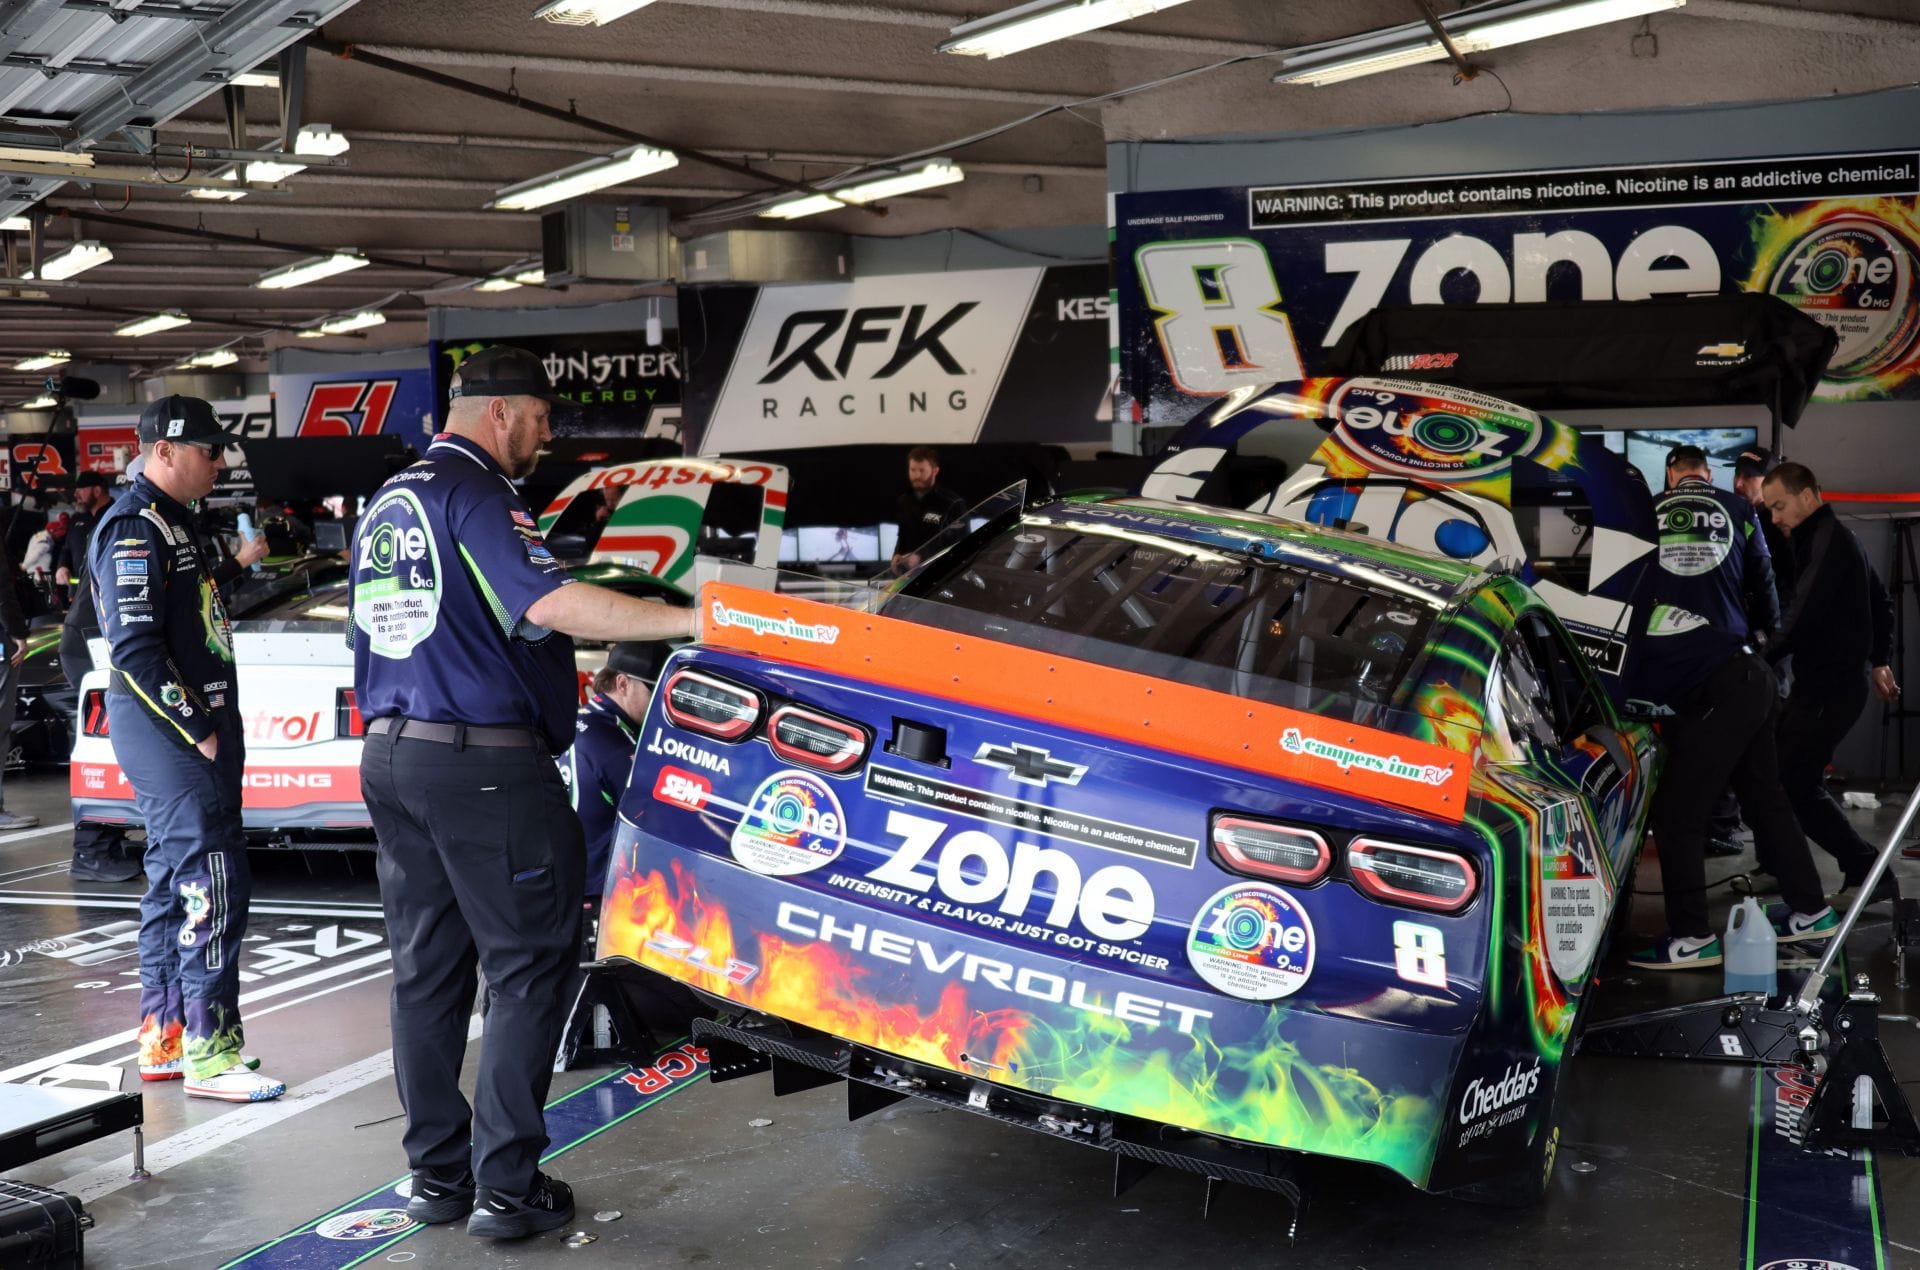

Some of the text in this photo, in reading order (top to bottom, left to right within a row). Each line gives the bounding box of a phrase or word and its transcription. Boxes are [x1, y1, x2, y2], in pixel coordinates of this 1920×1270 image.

[1256, 164, 1916, 214] WARNING: This product contains nicotine. Nicotine is an addictive chemical.
[1127, 213, 1224, 226] UNDERAGE SALE PROHIBITED
[1826, 231, 1851, 242] NICOTINE
[1852, 231, 1876, 244] POUCHES
[1790, 250, 1894, 292] zone
[1858, 289, 1872, 308] 6
[1136, 238, 1306, 396] 8
[1824, 312, 1868, 324] This product
[1840, 323, 1870, 334] Nicotine
[757, 301, 981, 384] RFK
[543, 351, 682, 385] ONSTER
[558, 388, 657, 402] NERGY
[1351, 388, 1396, 406] 6 MG
[1383, 382, 1423, 393] product
[1424, 388, 1447, 398] This
[298, 379, 397, 438] 51
[763, 390, 967, 418] RACING
[1440, 402, 1529, 429] JALAPEÑO LIME
[1345, 406, 1510, 458] zone
[1371, 444, 1407, 464] POUCHES
[1408, 457, 1451, 469] NICOTINE
[1657, 507, 1726, 532] zone
[359, 522, 427, 574] zone
[1709, 530, 1719, 542] 6
[118, 576, 148, 585] COMETIC
[410, 566, 421, 588] 6
[378, 624, 386, 633] is
[728, 607, 839, 643] campers inn RV
[204, 681, 228, 692] sparco
[244, 711, 321, 742] trol
[662, 739, 731, 777] OKUMA
[1304, 739, 1449, 784] campers inn RV
[243, 773, 332, 788] CING
[660, 774, 703, 807] SEM
[753, 793, 839, 837] zone
[874, 773, 1188, 857] WARNING: This product contains nicotine. Nicotine is an addictive chemical.
[808, 838, 822, 852] 6
[865, 810, 1155, 942] zone
[1242, 891, 1267, 900] NICOTINE
[1267, 894, 1290, 911] POUCHES
[1577, 904, 1595, 917] Nicotine
[828, 873, 1170, 972] INTENSITY & FLAVOR JUST GOT SPICIER
[1207, 906, 1306, 952] zone
[1277, 955, 1303, 973] 9 MG
[1393, 921, 1447, 989] 8
[775, 901, 1214, 1035] CHEVROLET
[1203, 962, 1230, 974] contains
[1261, 976, 1288, 986] Nicotine
[1245, 965, 1259, 974] This
[1260, 969, 1285, 979] product
[1238, 976, 1267, 988] addictive
[1719, 1034, 1745, 1057] 8
[1460, 1055, 1541, 1125] Cheddar's
[1498, 1103, 1528, 1128] KITCHEN
